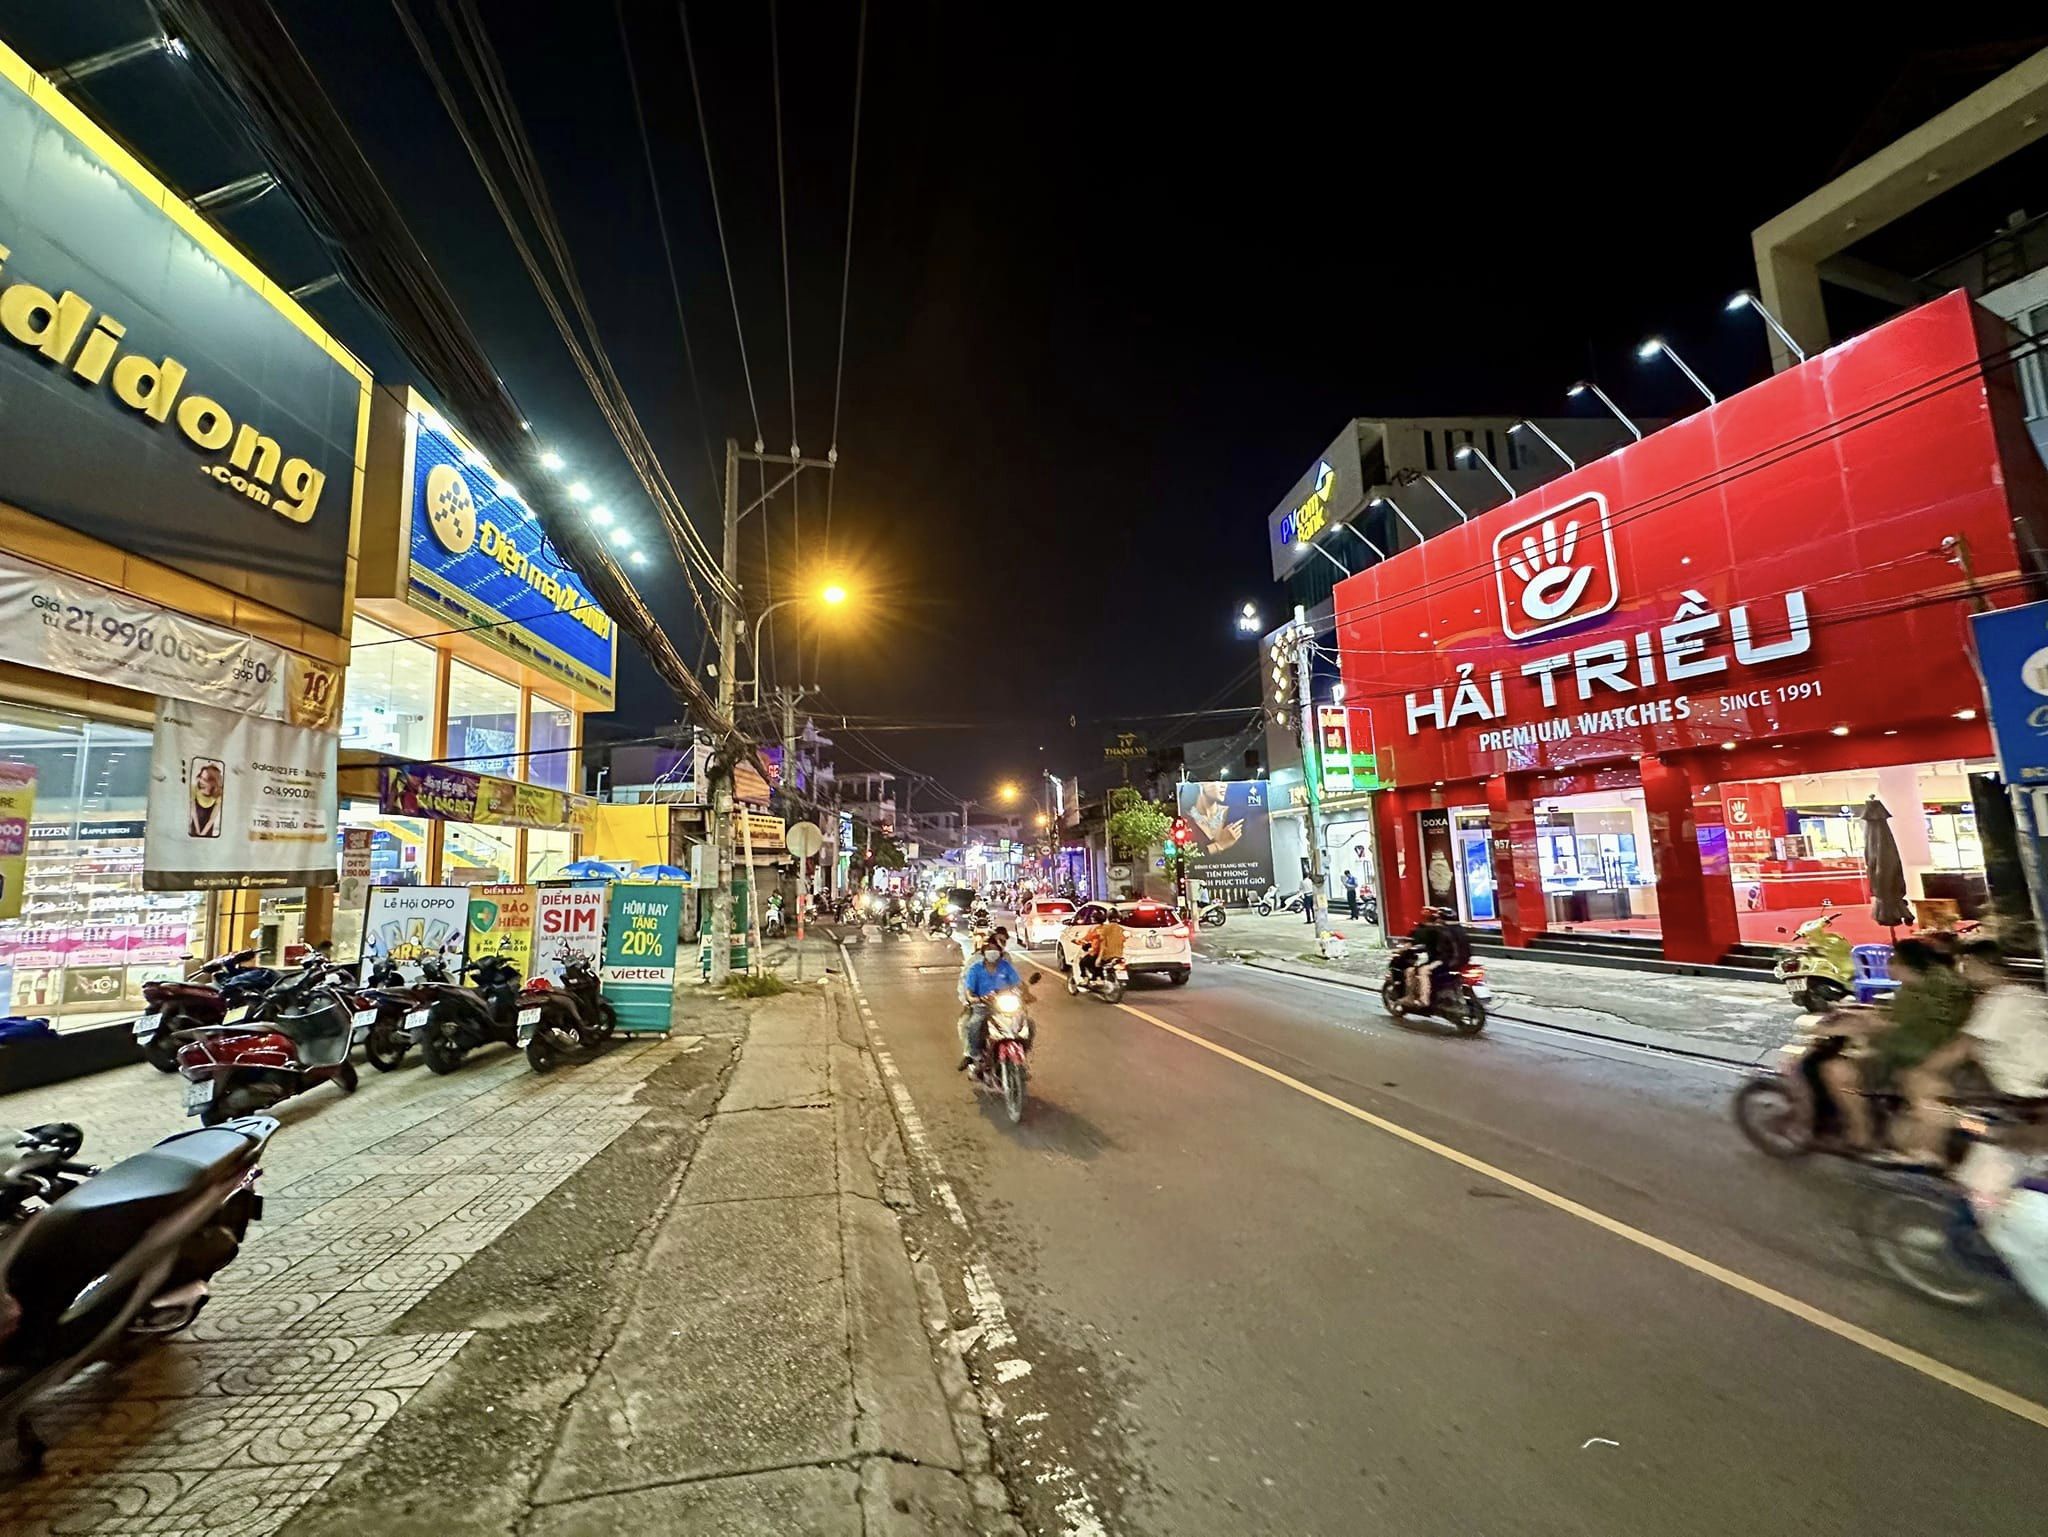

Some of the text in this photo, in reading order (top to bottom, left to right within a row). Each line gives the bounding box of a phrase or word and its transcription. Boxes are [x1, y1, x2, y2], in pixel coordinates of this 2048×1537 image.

[0, 244, 326, 523] didong
[201, 464, 271, 505] .com
[479, 519, 529, 581] Điện
[1405, 588, 1811, 736] HẢI TRIỀU
[1720, 679, 1823, 713] SINCE 1991
[1479, 695, 1692, 752] PREMIUM WATCHES
[28, 826, 71, 837] ITIZEN
[1422, 818, 1449, 827] DOXA
[1494, 839, 1510, 849] 957
[400, 899, 418, 909] Hội
[421, 898, 455, 909] OPPO
[501, 899, 529, 912] BẢO
[541, 889, 600, 905] ĐIỂM BÁN
[622, 900, 669, 916] HÔM NAY
[543, 908, 597, 933] SIM
[621, 930, 662, 957] 20%
[611, 968, 666, 979] viettel
